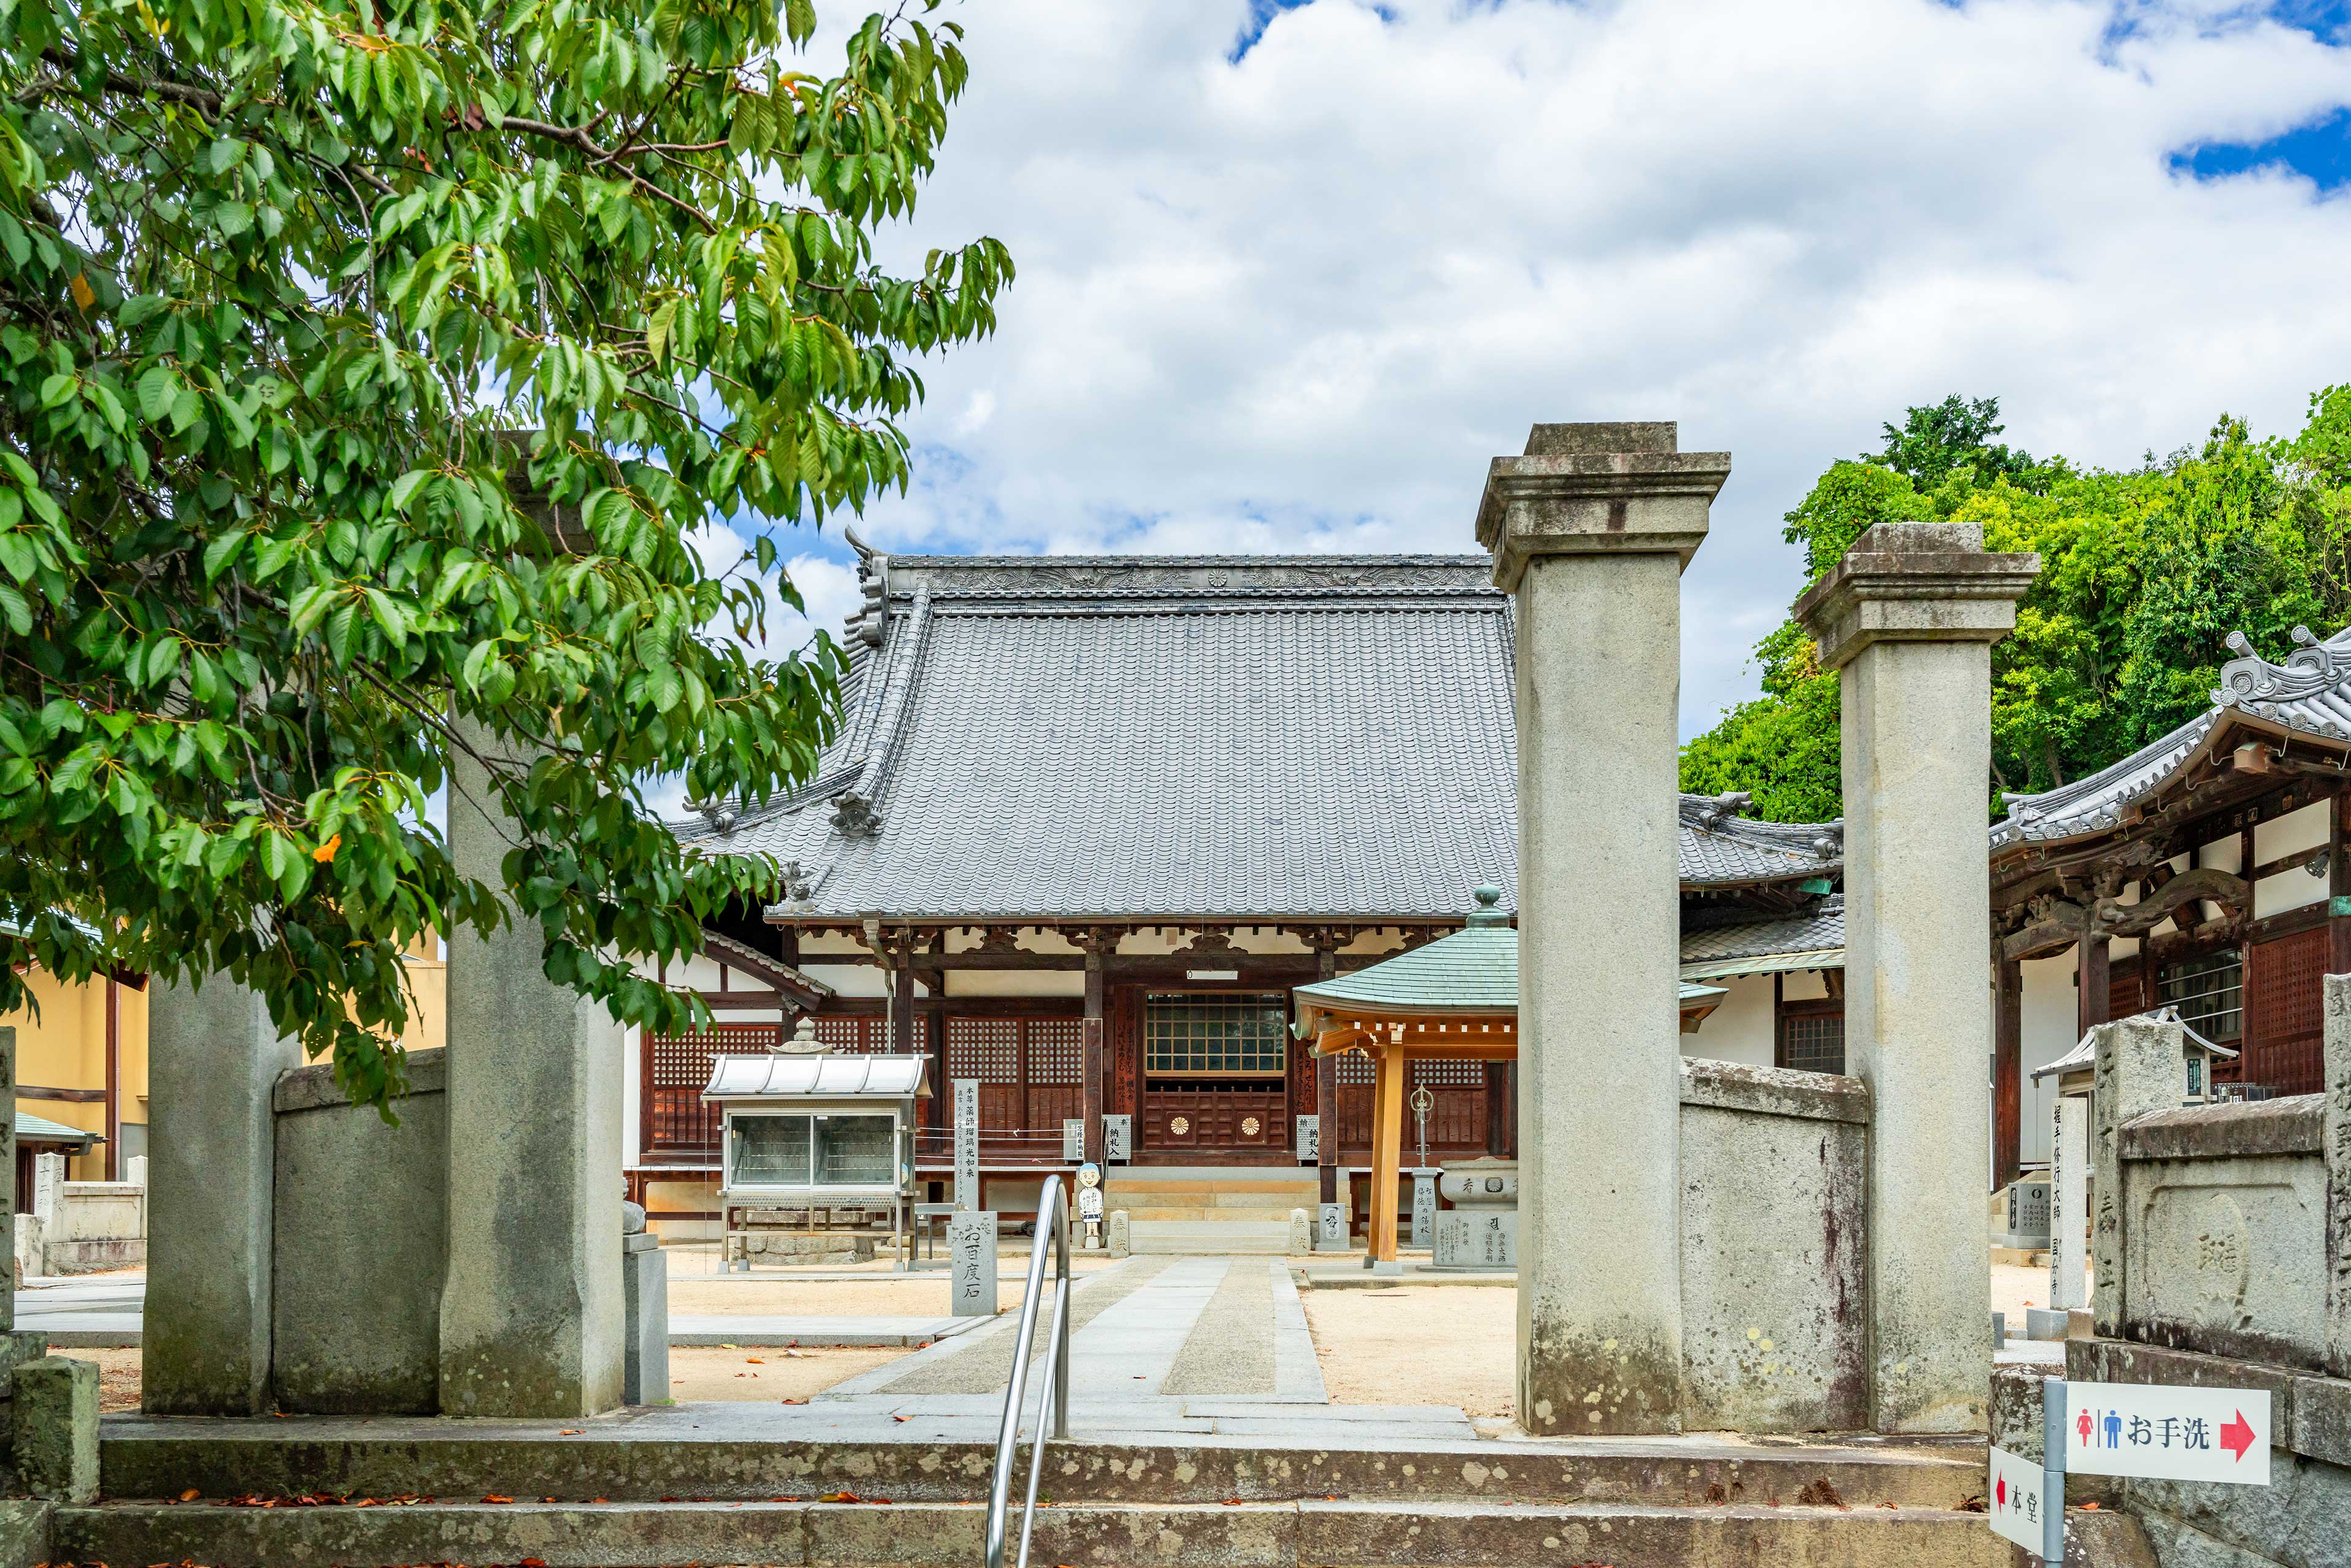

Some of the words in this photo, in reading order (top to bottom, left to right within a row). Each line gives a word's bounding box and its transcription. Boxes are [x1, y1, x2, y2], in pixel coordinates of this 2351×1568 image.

[1109, 1128, 1120, 1155] 納札入
[1308, 1128, 1319, 1156] 納札入
[2053, 1105, 2061, 1223] 握手修行大師
[962, 1223, 981, 1299] お百度石
[2128, 1414, 2210, 1450] お手洗
[2011, 1485, 2037, 1524] 本堂
